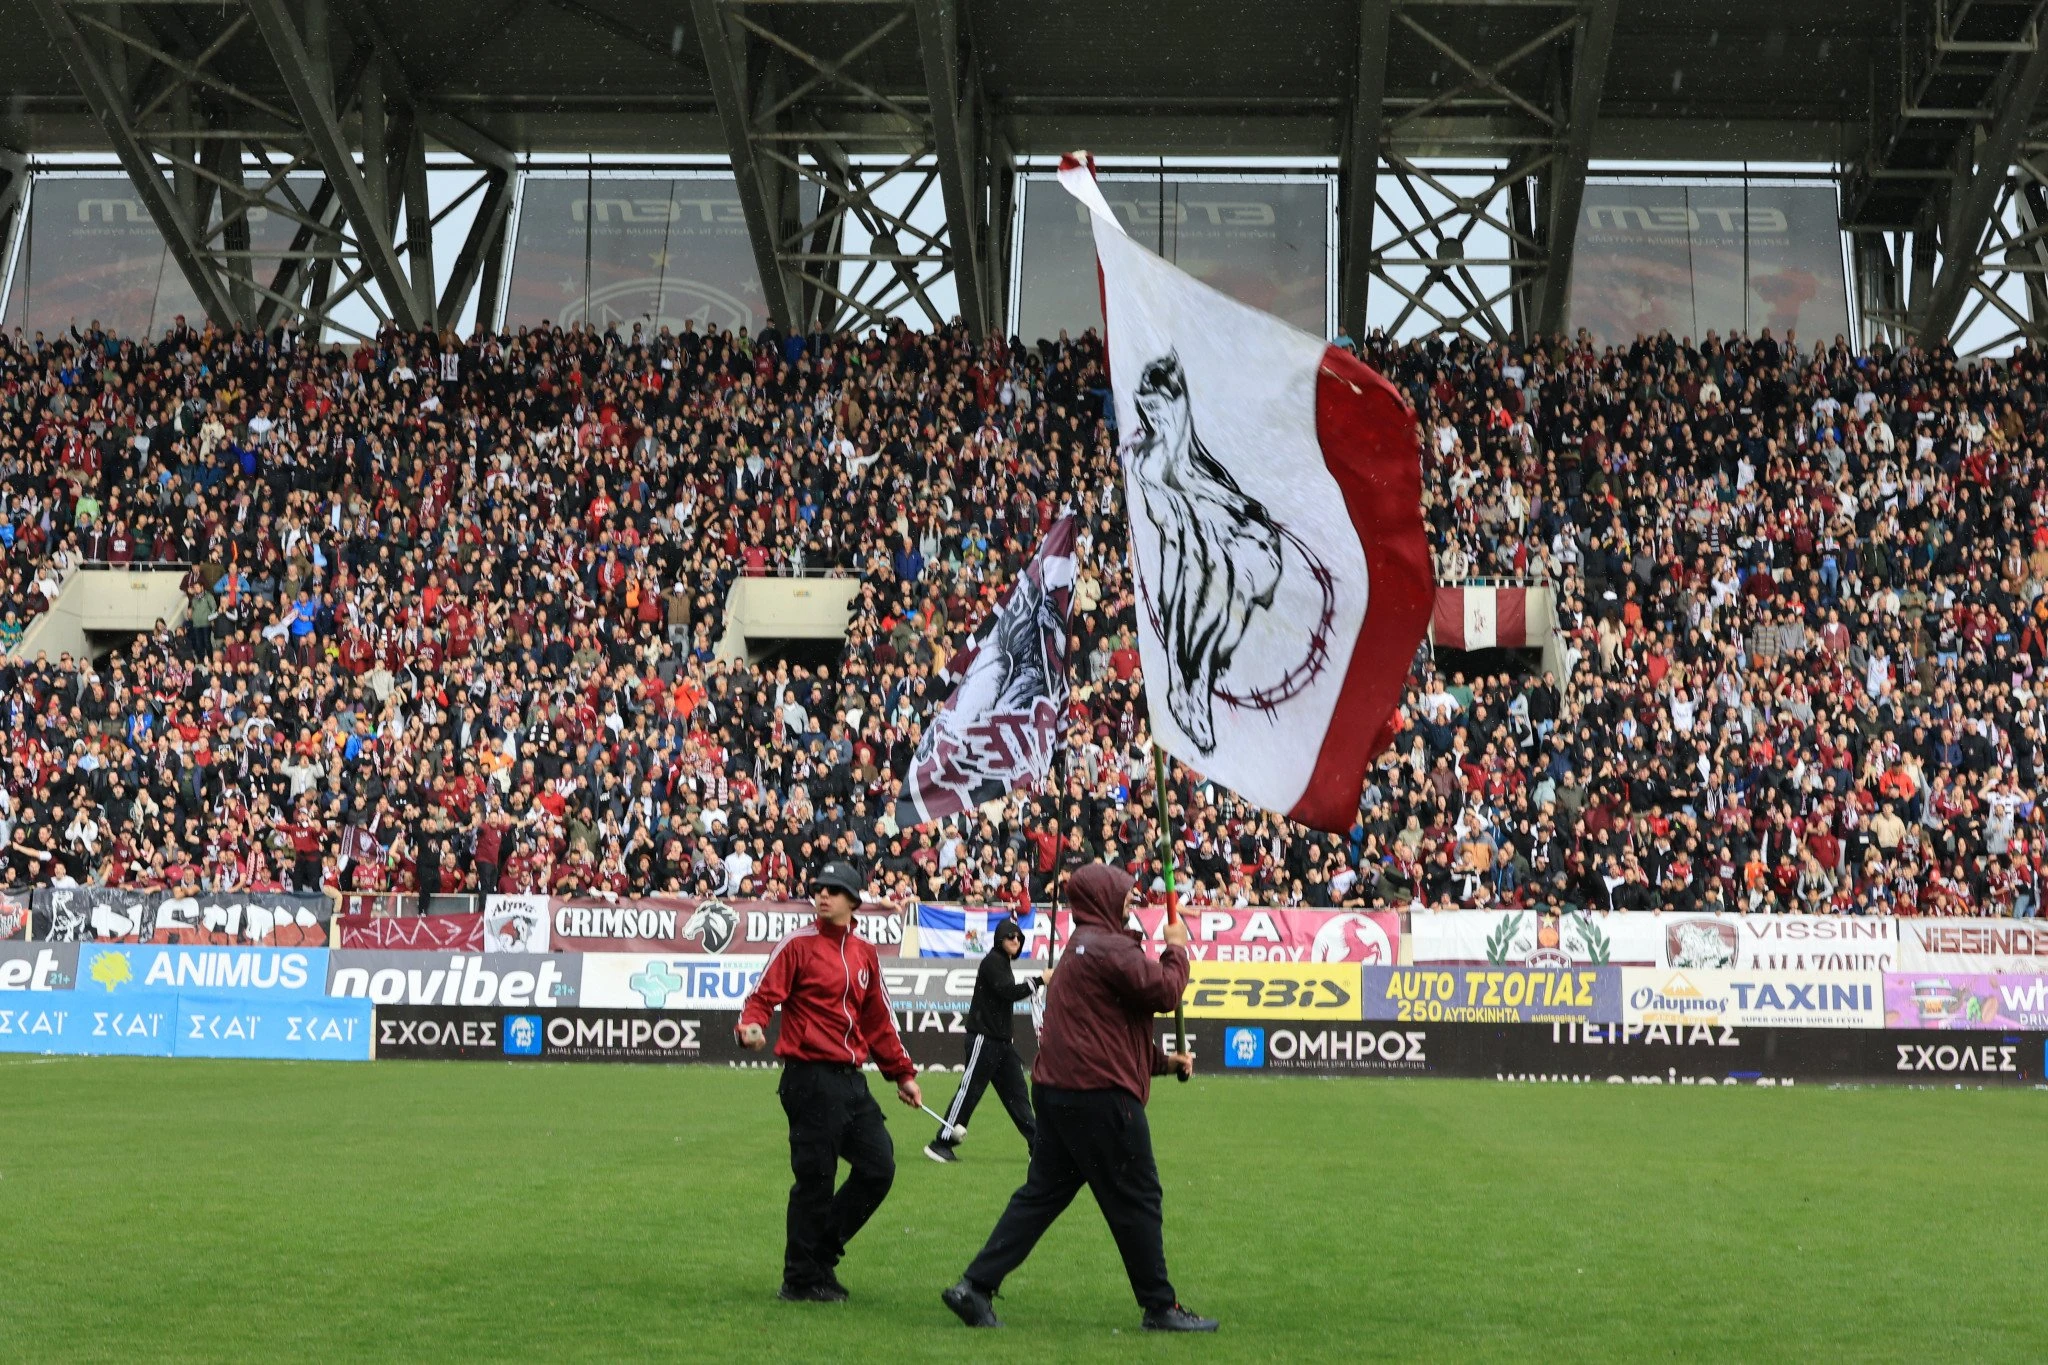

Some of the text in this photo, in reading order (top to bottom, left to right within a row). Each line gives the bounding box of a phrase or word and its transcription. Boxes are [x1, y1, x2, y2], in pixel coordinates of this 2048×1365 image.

[554, 906, 902, 946] CRIMSON DEFEERS
[1746, 921, 1888, 939] VISSINI
[49, 973, 71, 984] 21+
[144, 951, 308, 989] ANIMUS
[330, 955, 576, 1008] novibet 21+
[1385, 971, 1597, 1007] AUTO ΤΣΟΓΙΑΣ
[928, 1001, 971, 1010] ALUMIN
[1397, 1000, 1521, 1024] 250 ΑΥΤΟΚΙΝΗΤΑ
[379, 1017, 701, 1050] ΣΧΟΛΕΣ ΟΜΗΡΟΣ
[1269, 1029, 1426, 1061] ΟΜΗΡΟΣ
[1896, 1044, 2017, 1072] ΣΧΟΛΕΣ
